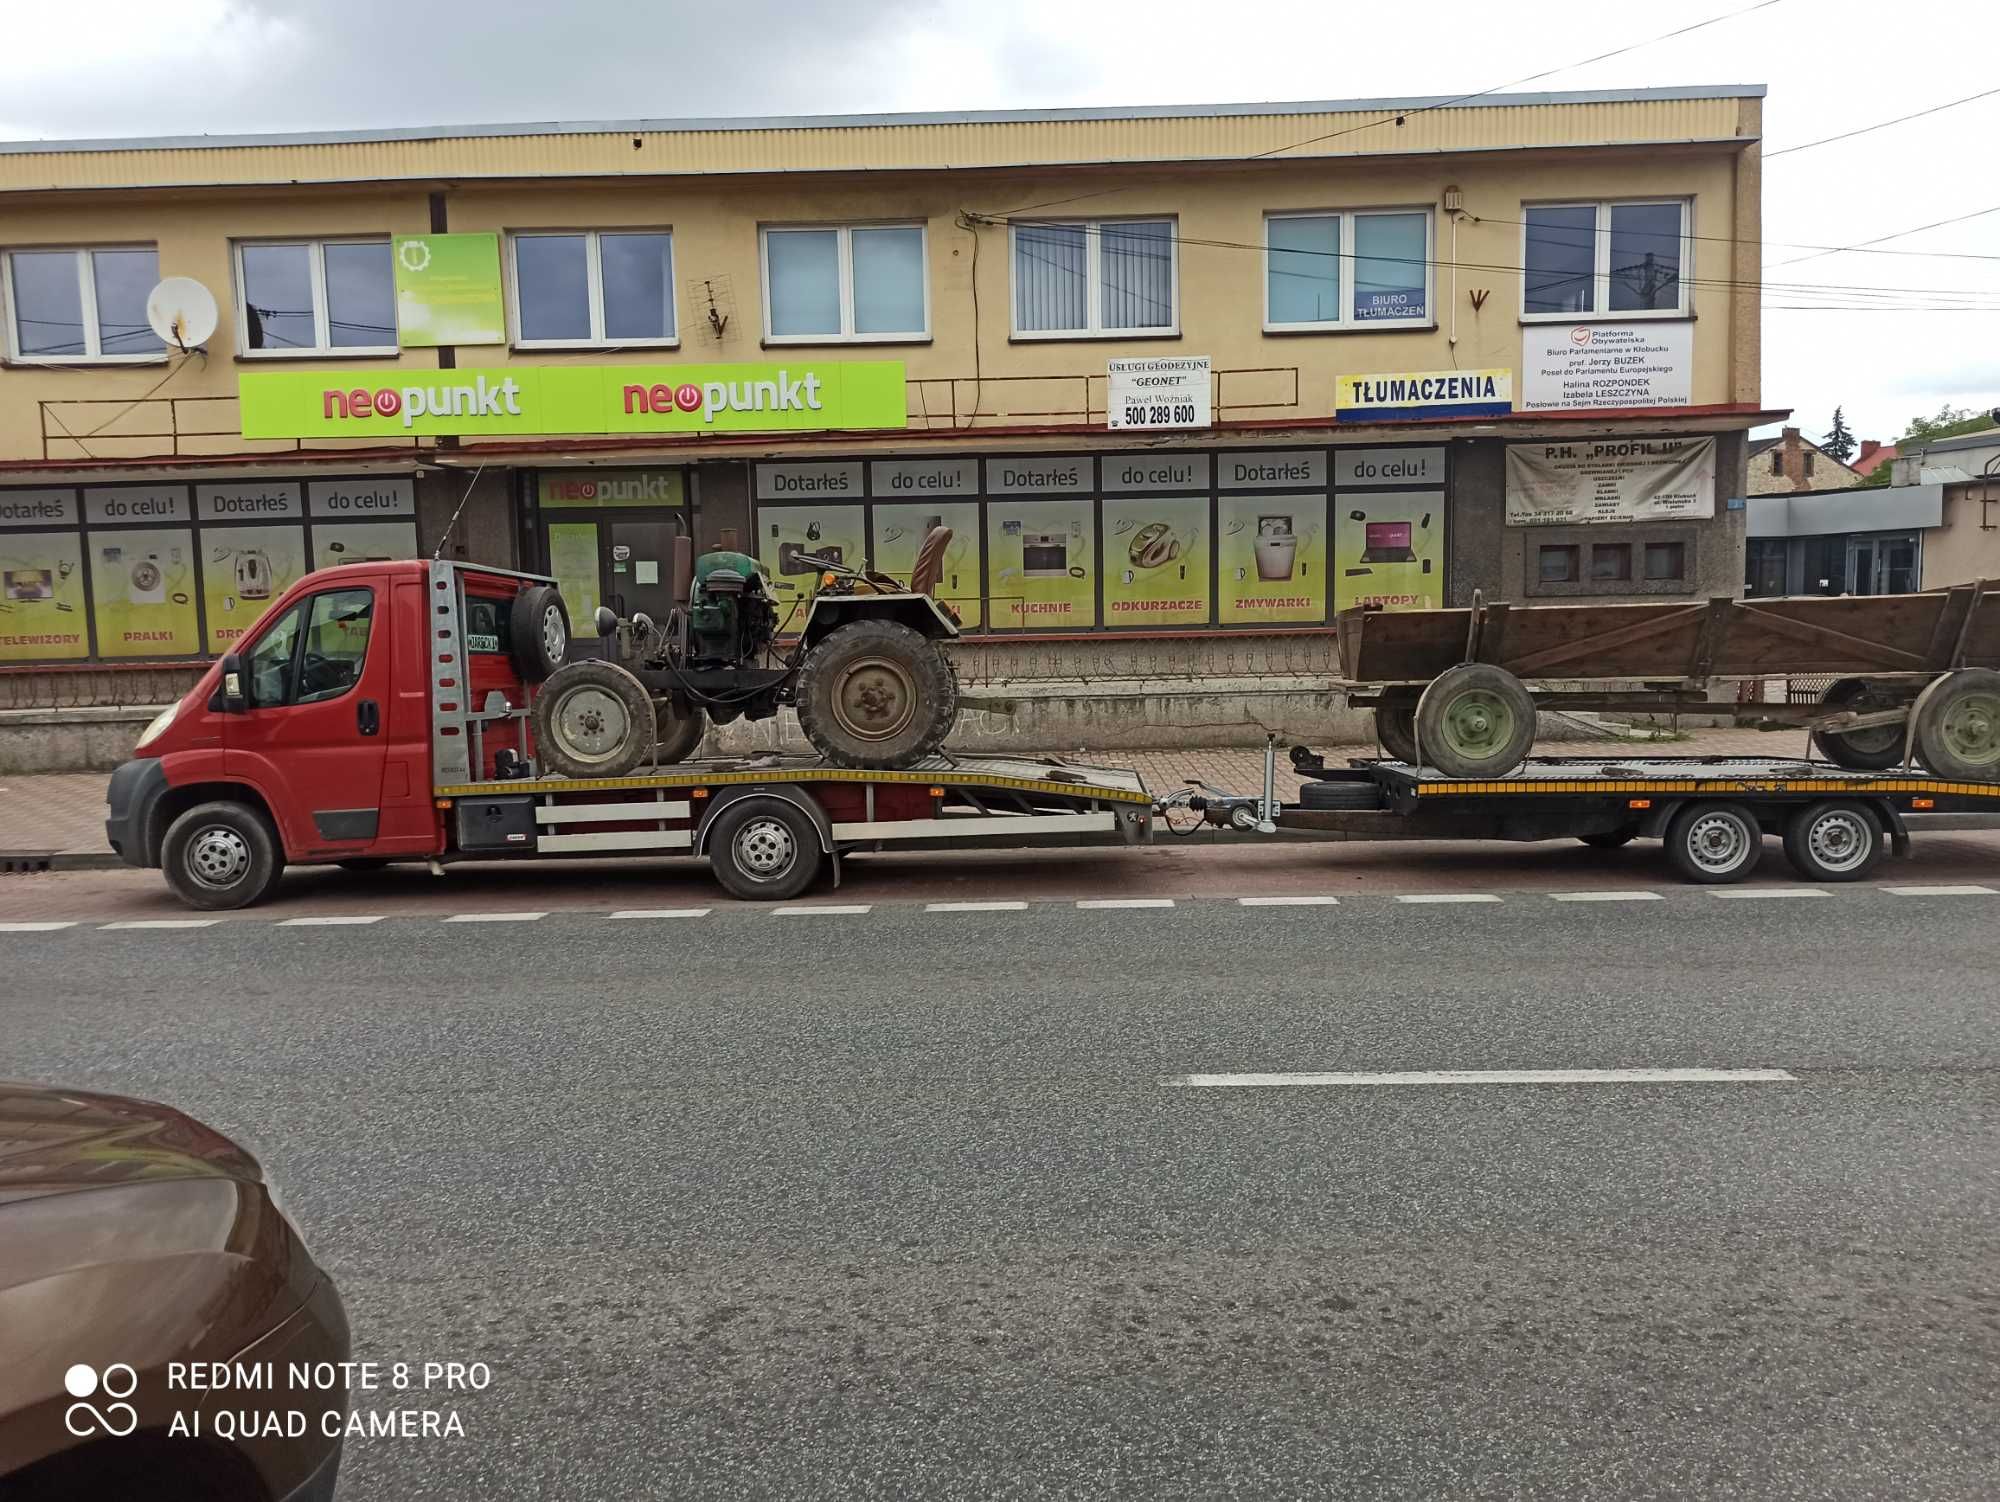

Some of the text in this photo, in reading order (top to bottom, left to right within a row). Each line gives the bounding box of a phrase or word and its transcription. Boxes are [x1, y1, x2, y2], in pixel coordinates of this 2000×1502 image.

[1372, 294, 1407, 305] BIURO
[1357, 304, 1424, 317] TŁUMACZEŃ
[1592, 337, 1645, 345] Obywatelska
[1546, 348, 1567, 356] Biuro
[1147, 360, 1209, 371] GEODEZYJNE
[1589, 358, 1611, 367] Jerzy
[1614, 356, 1645, 365] BUZEK
[1564, 368, 1574, 376] do
[1575, 367, 1618, 375] Parlamentu
[1620, 365, 1673, 374] Europejskiego
[1352, 375, 1496, 403] TŁUMACZENIA
[1563, 378, 1650, 389] Halina ROZPONDEK
[323, 375, 521, 428] neopunkt
[623, 370, 822, 423] neopunkt
[1563, 388, 1650, 399] Izabela LESZCZYNA
[1125, 404, 1195, 425] 500 289 600
[1121, 464, 1193, 484] do celu!
[1234, 460, 1311, 481] Dotarłeś
[1354, 458, 1427, 478] do celu!
[774, 472, 849, 492] Dotarłeś
[891, 470, 961, 489] do celu!
[1003, 467, 1078, 488] Dotarłeś
[548, 473, 669, 507] neopunkt
[105, 496, 175, 516] do celu!
[213, 492, 289, 513] Dotarłeś
[327, 489, 398, 510] do celu!
[0, 499, 65, 519] otarłeś
[1011, 602, 1072, 614] KUCHNIE
[1111, 599, 1203, 612] ODKURZACZE
[1235, 597, 1311, 609] ZMYWARKI
[0, 634, 80, 645] TELEWIZORY
[123, 631, 174, 642] PRALKI
[215, 628, 245, 639] DRO
